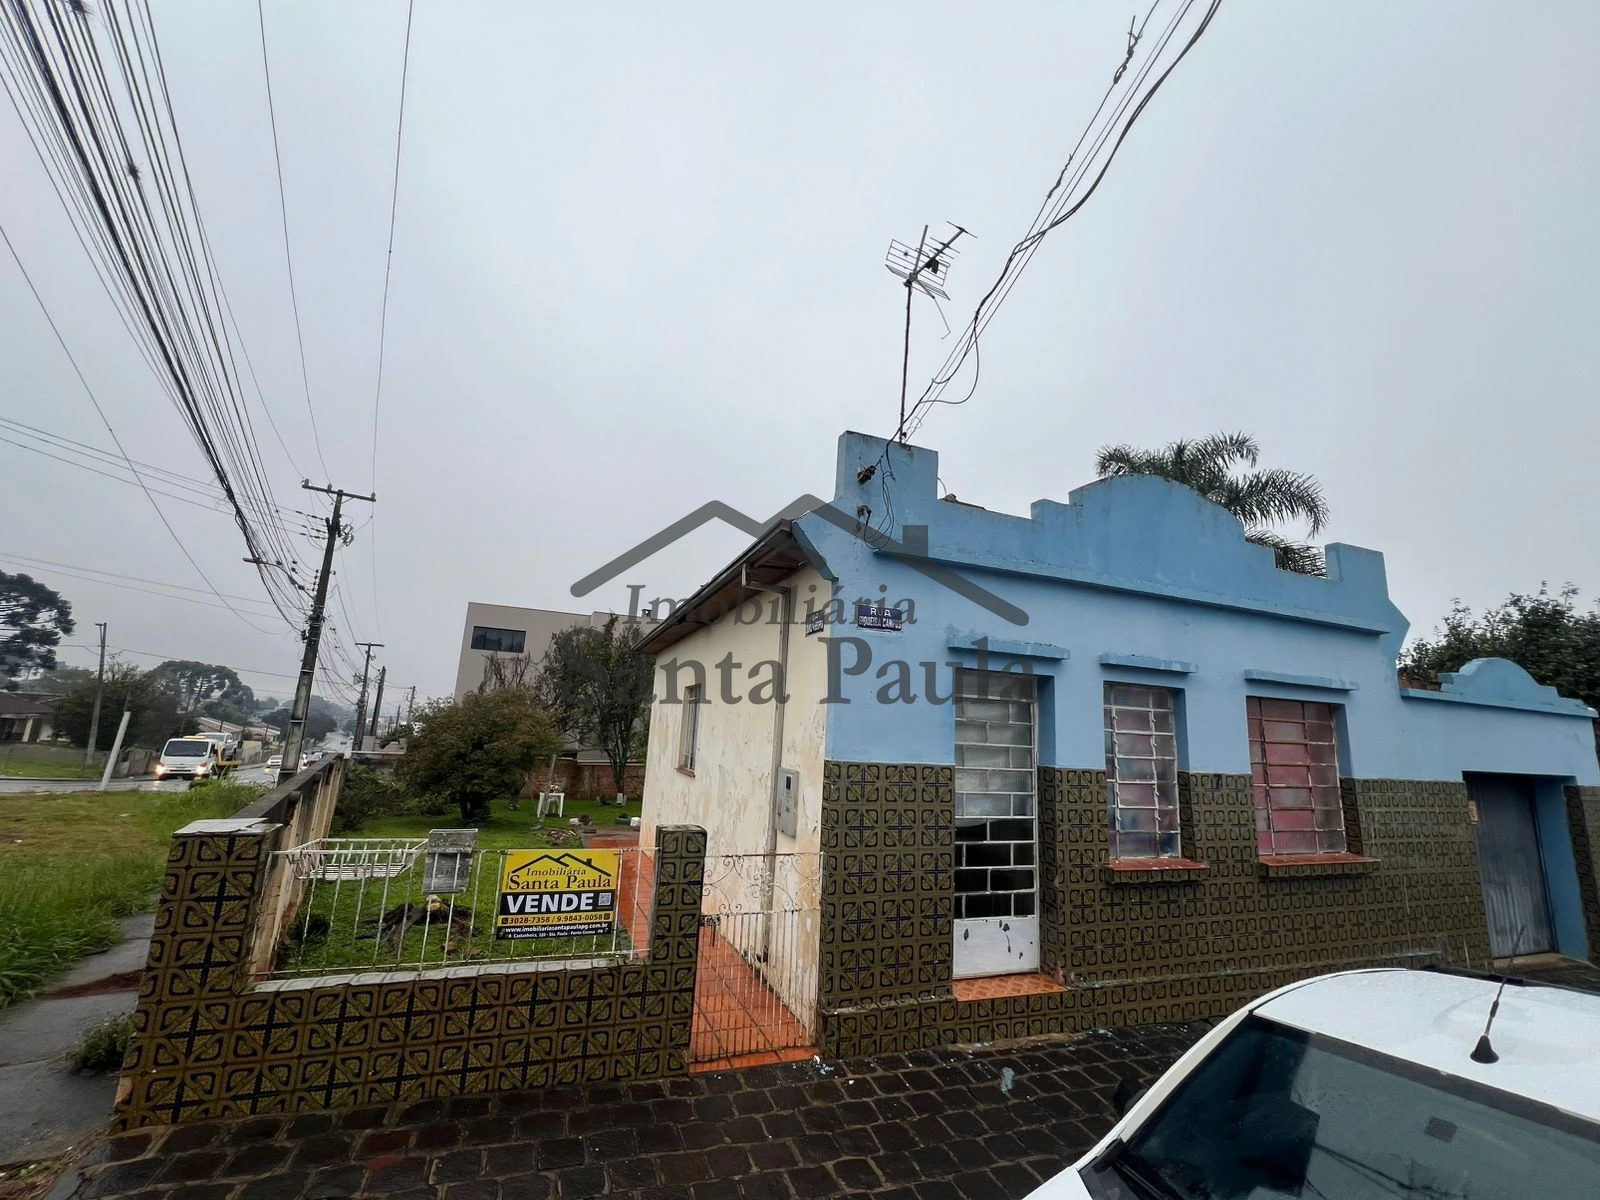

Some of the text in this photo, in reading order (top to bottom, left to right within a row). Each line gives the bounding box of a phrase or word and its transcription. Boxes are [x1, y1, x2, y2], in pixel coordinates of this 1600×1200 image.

[870, 607, 891, 617] RUA
[526, 867, 587, 876] Imobiliária
[509, 875, 560, 890] Santa
[565, 875, 611, 889] Paula
[506, 893, 594, 913] VENDE
